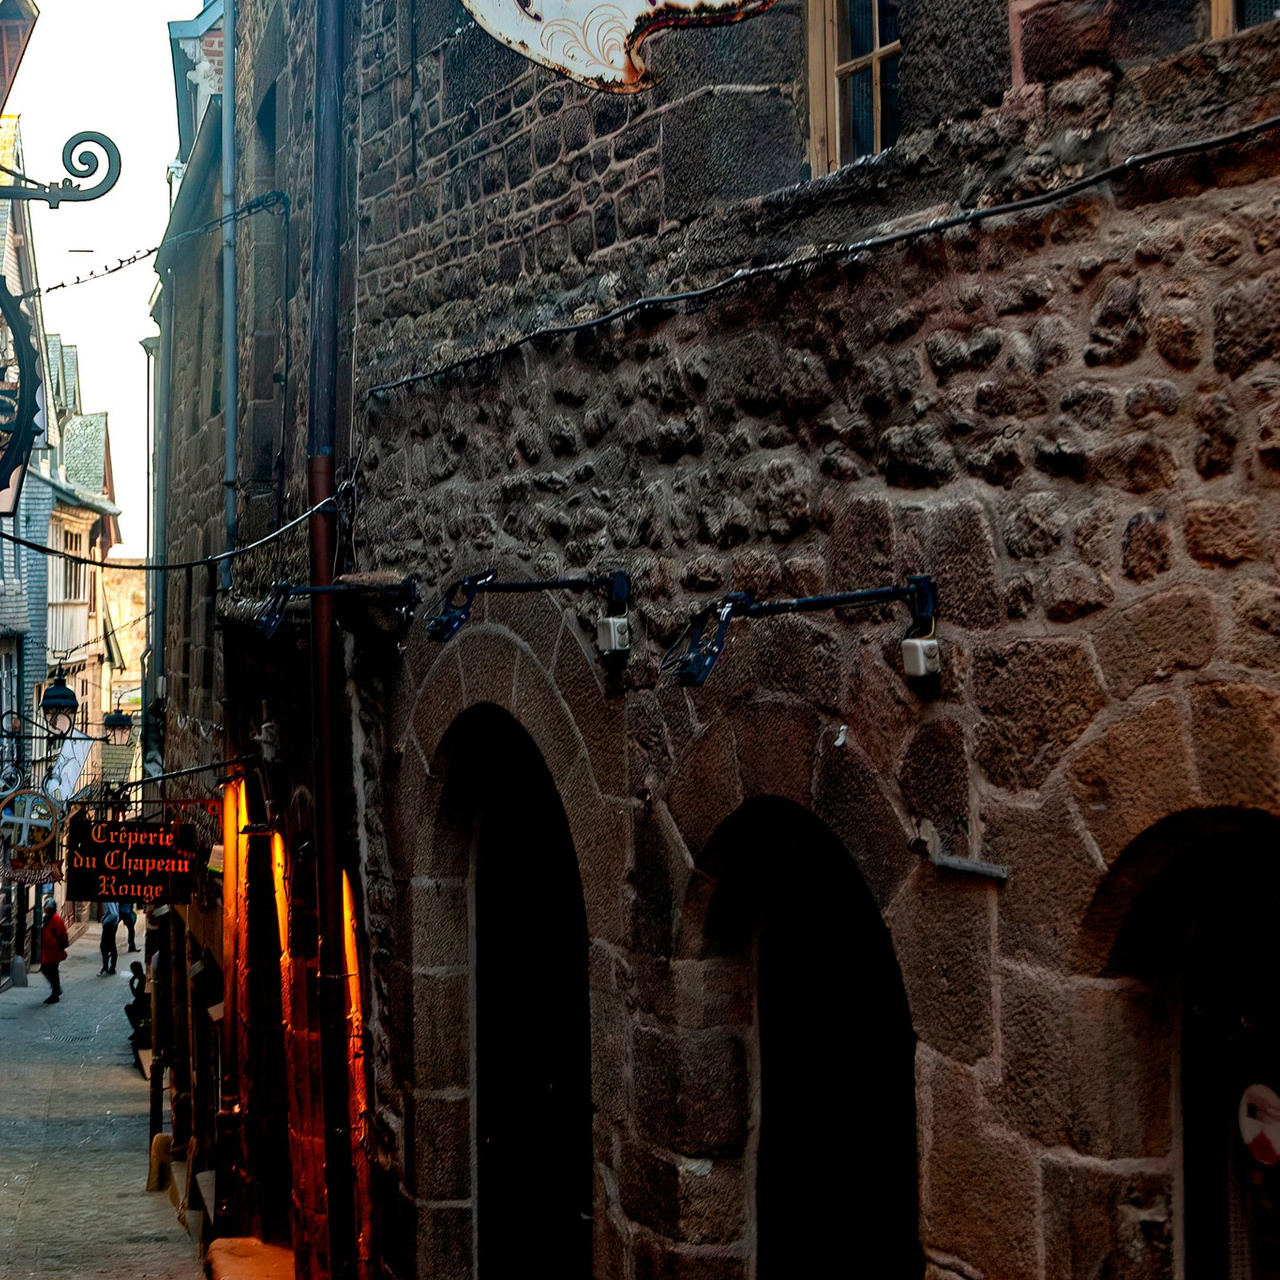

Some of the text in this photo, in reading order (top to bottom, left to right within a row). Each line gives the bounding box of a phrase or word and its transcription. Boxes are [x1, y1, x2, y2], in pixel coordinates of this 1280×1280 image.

[91, 823, 174, 850] Crêperie
[73, 850, 97, 869] du
[104, 849, 190, 877] Chapeau
[98, 875, 163, 903] Rouge
